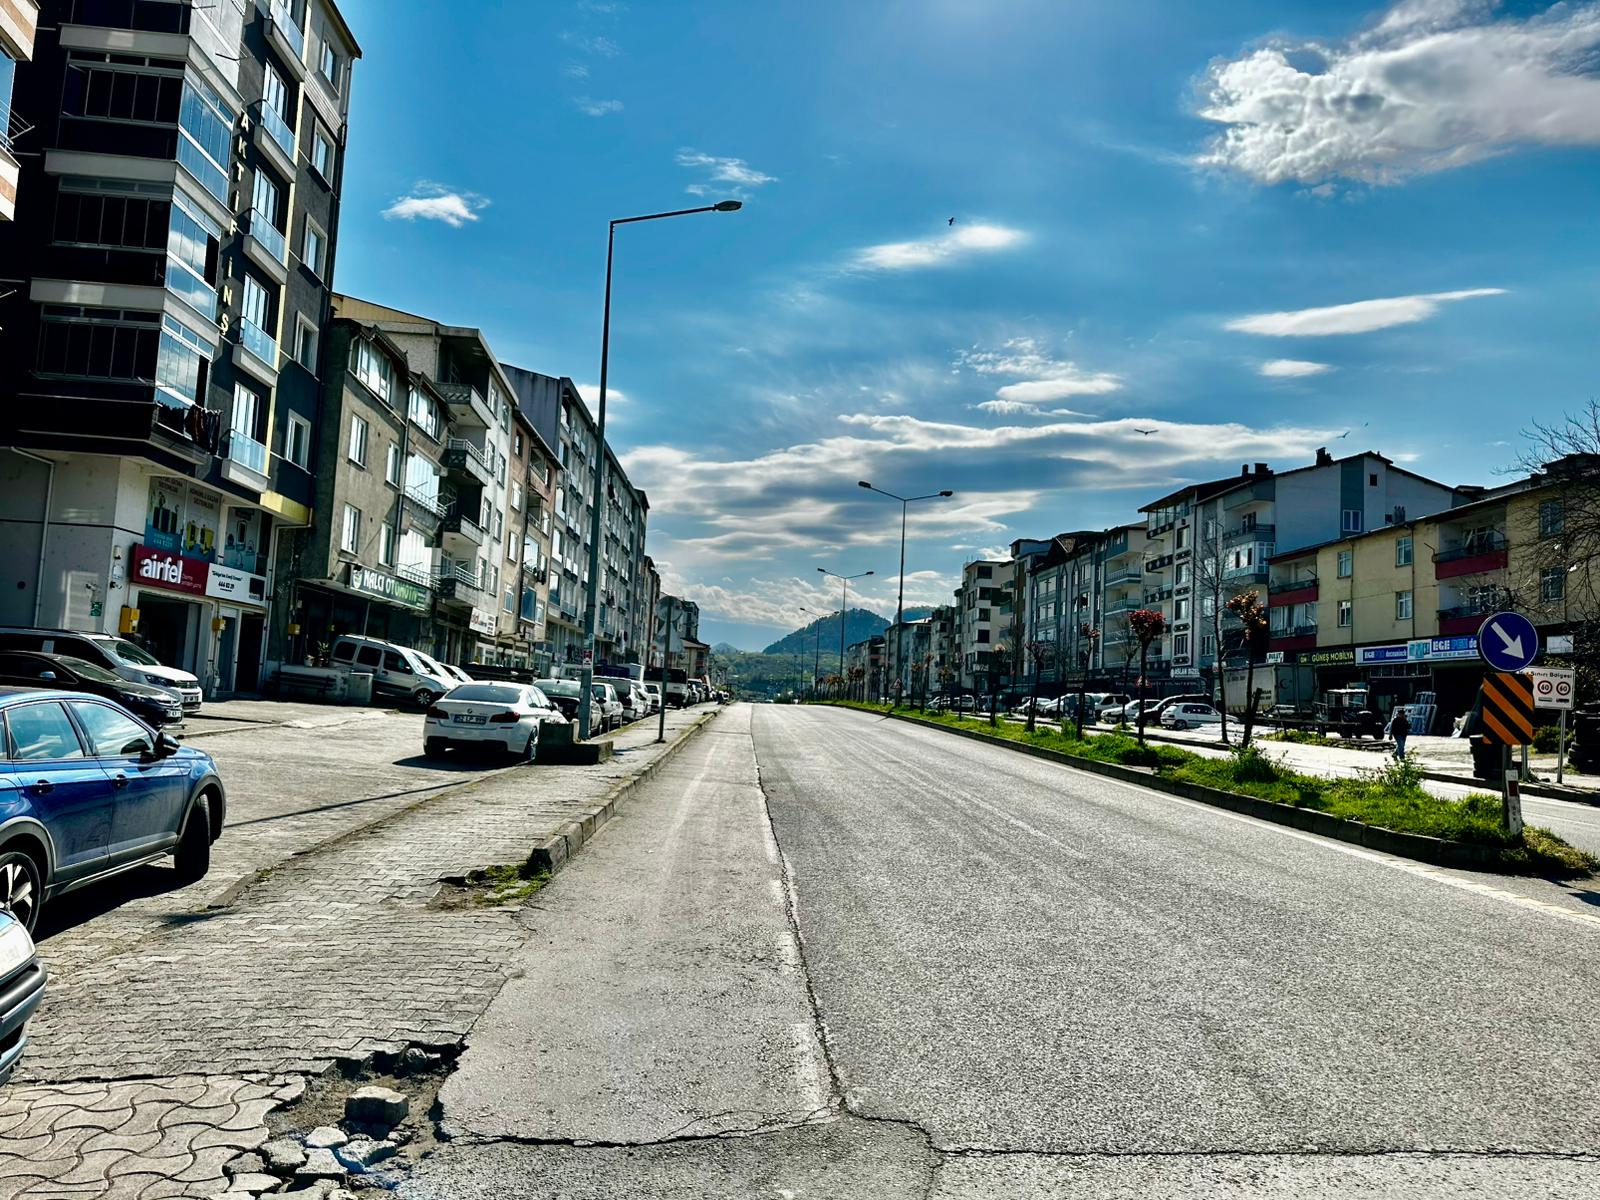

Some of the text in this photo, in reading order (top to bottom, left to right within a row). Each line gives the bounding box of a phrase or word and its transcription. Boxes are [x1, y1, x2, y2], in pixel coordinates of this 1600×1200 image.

[139, 554, 183, 584] airfel
[1433, 641, 1450, 651] EGE
[1311, 650, 1354, 663] GÜNEŞ MOBİLYA
